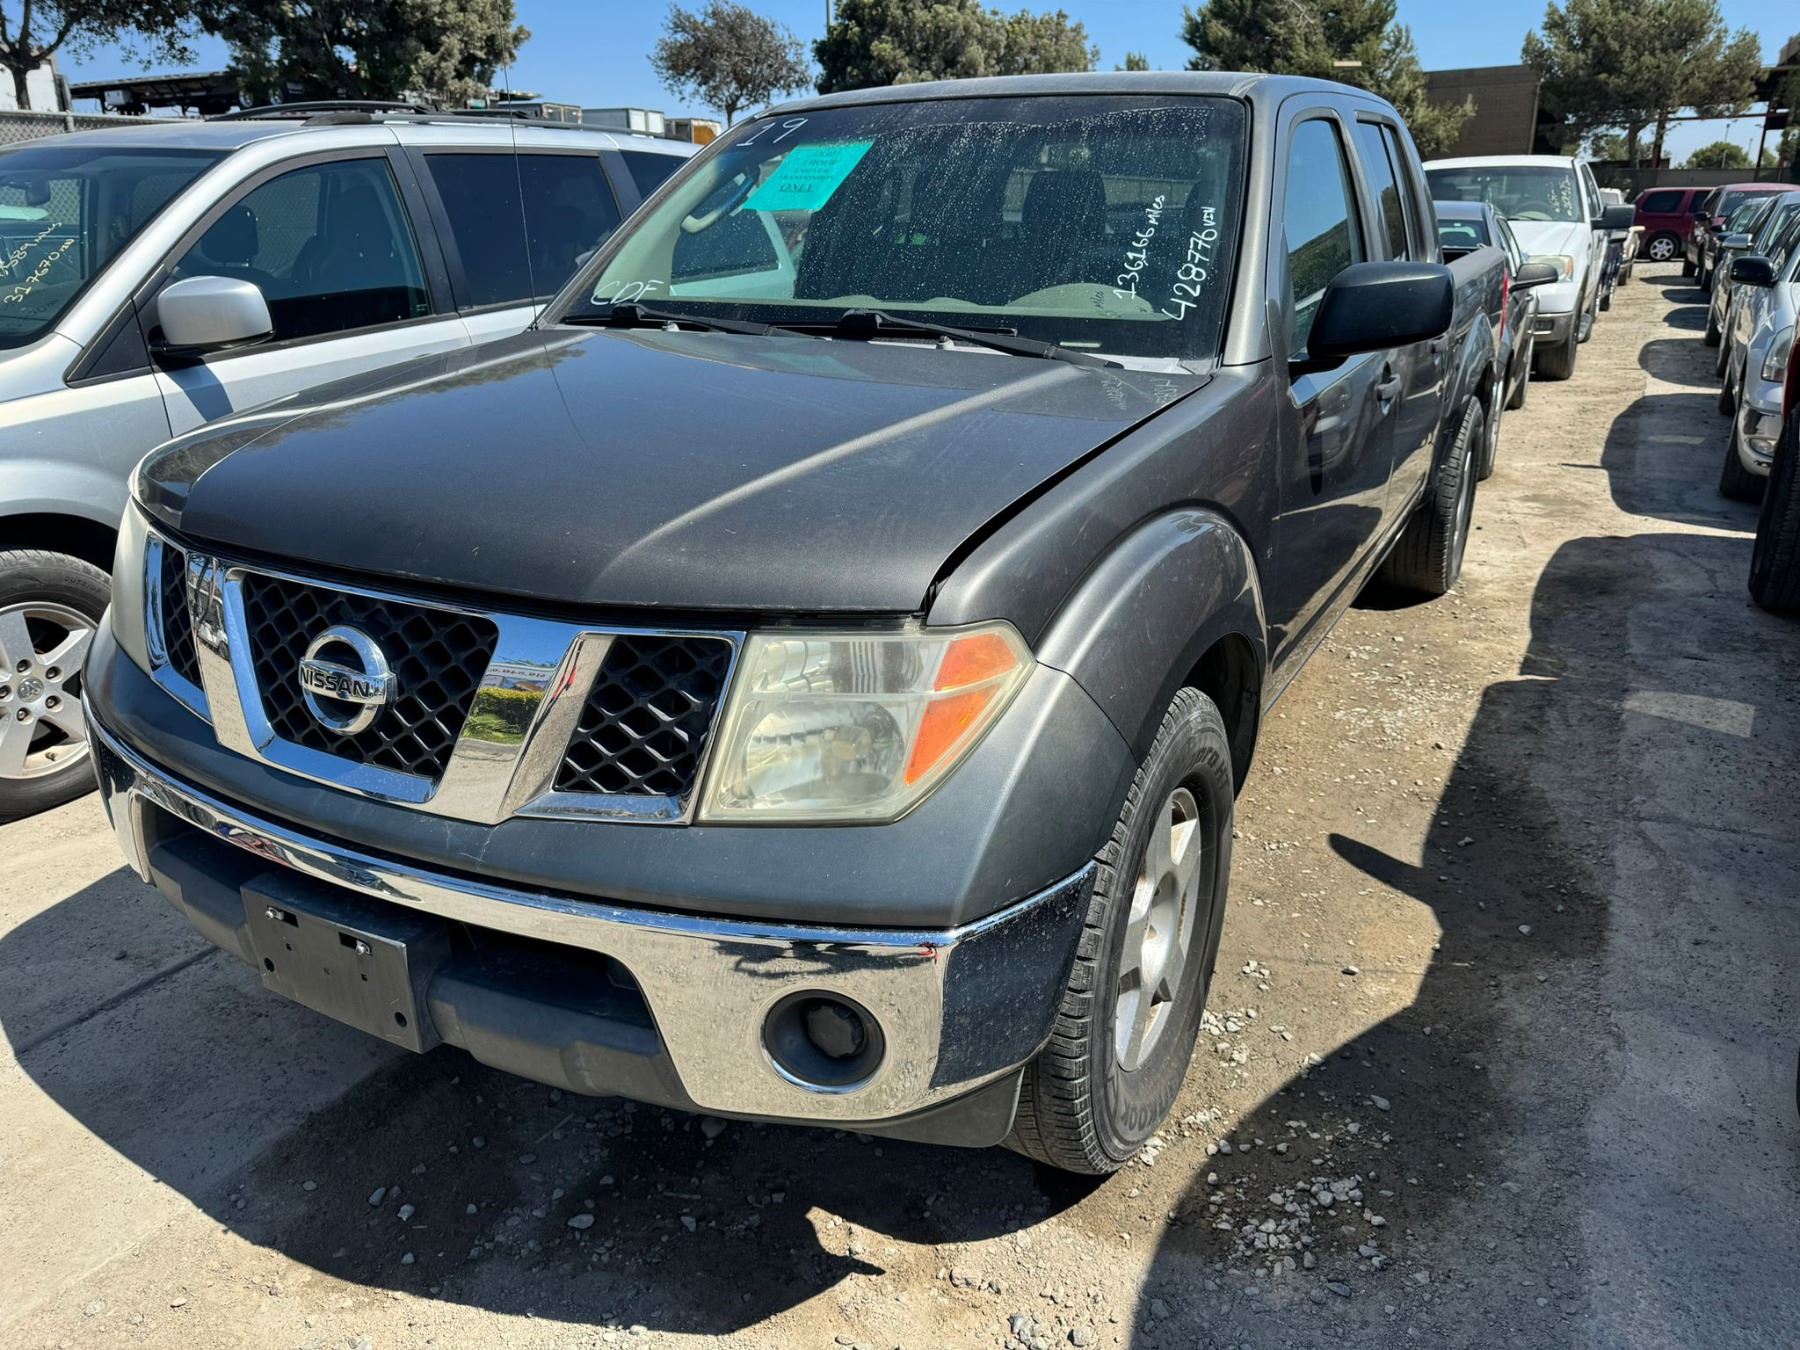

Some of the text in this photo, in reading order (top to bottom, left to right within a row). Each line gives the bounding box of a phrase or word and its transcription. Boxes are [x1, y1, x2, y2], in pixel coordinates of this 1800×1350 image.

[736, 118, 809, 147] 19
[1161, 206, 1218, 321] 428776 VIN
[590, 280, 664, 305] CDF
[301, 665, 370, 698] NISSAN
